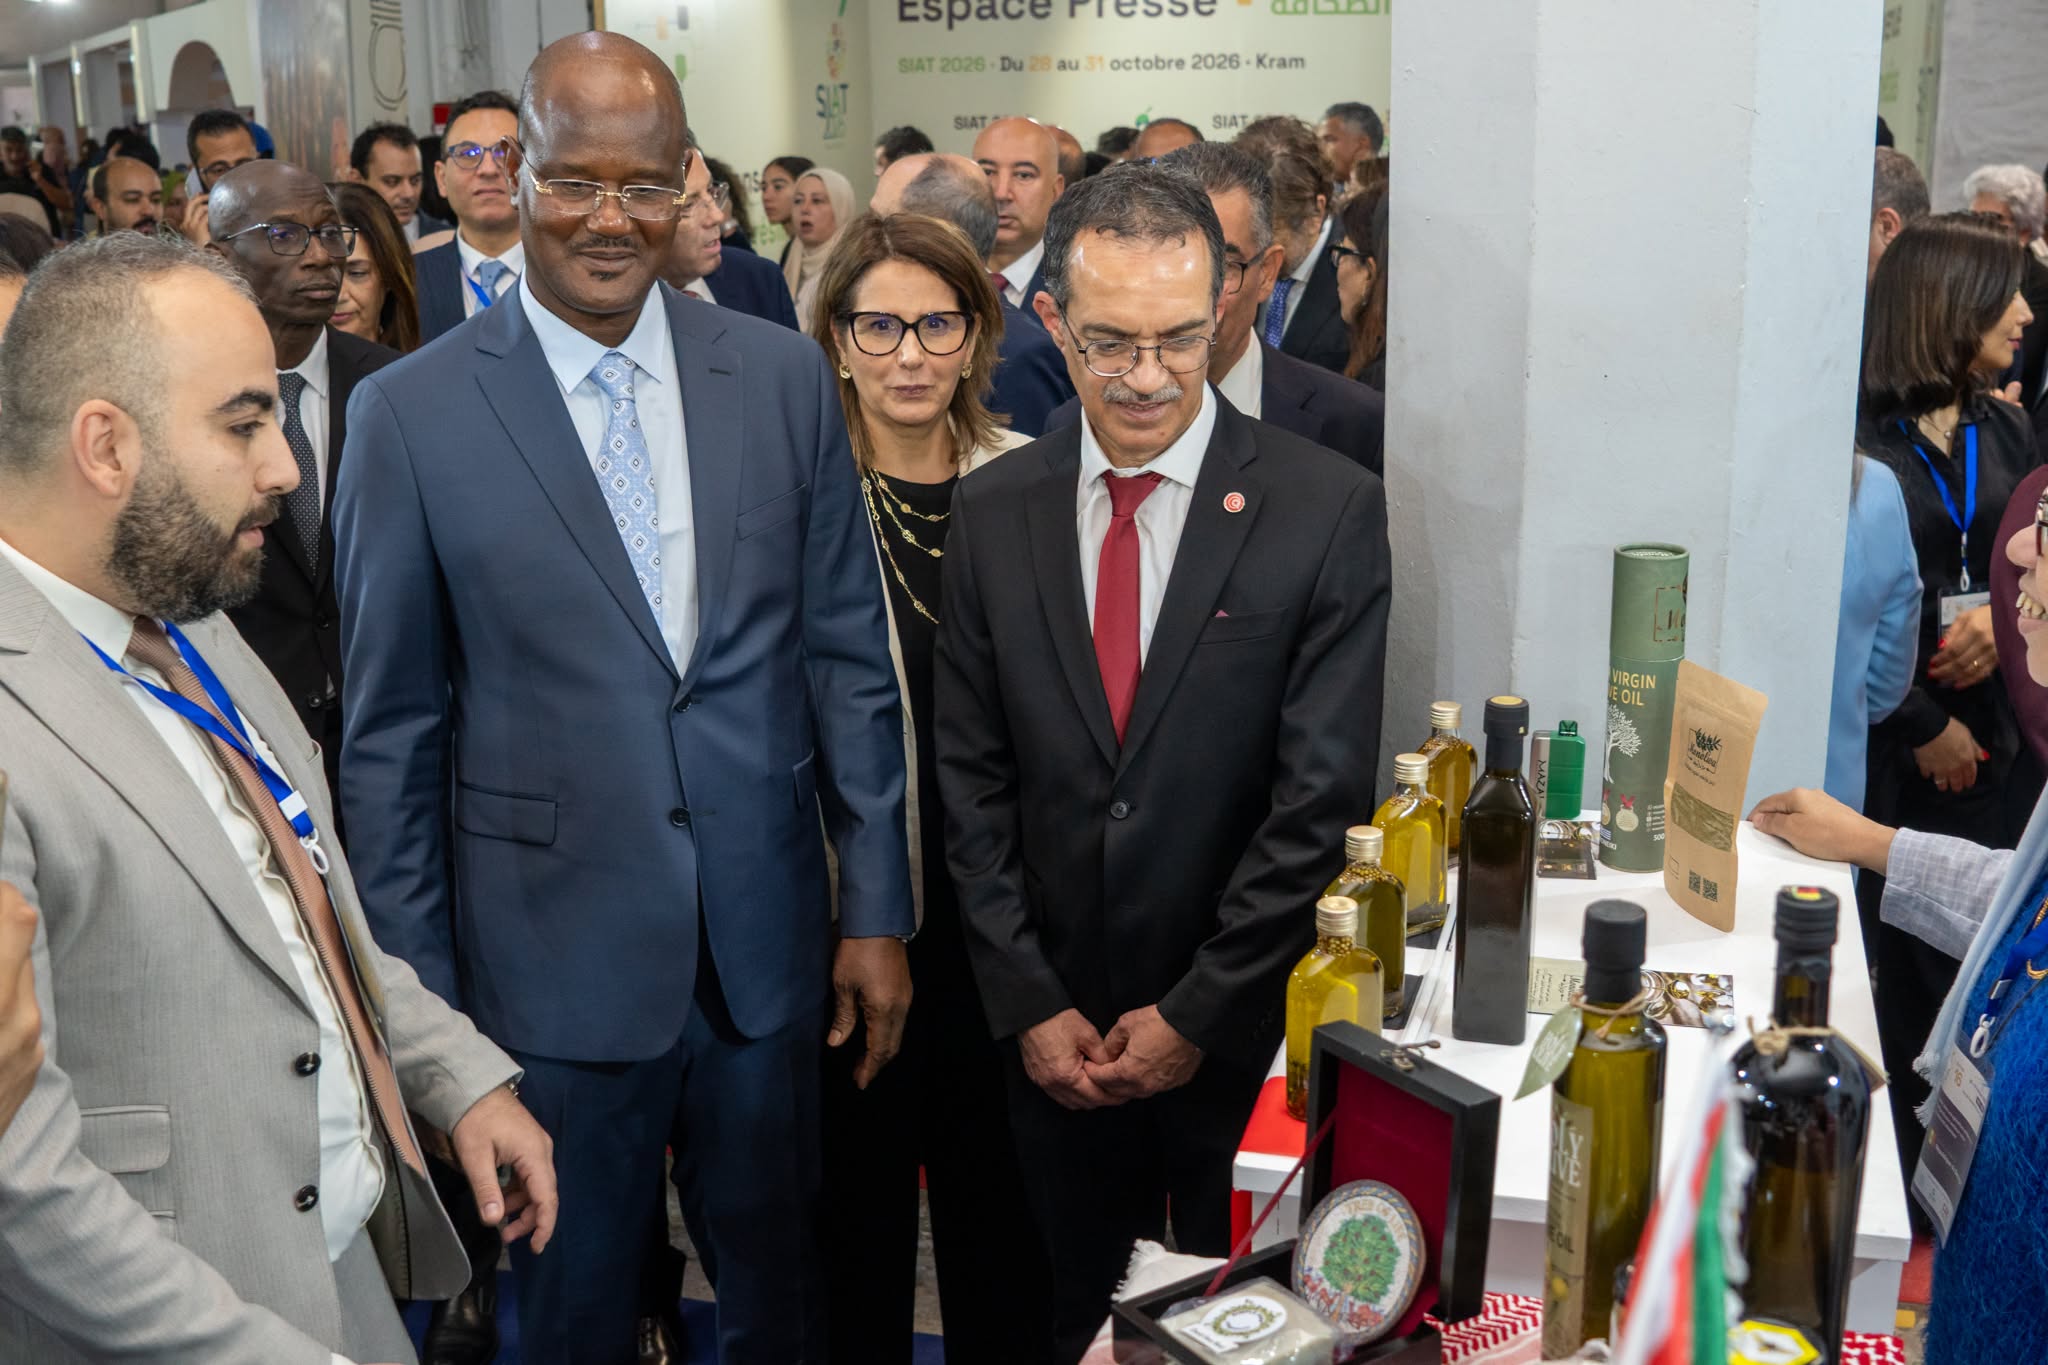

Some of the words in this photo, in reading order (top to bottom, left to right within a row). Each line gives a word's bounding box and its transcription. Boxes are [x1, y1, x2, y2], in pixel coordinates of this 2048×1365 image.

[897, 0, 1053, 31] Espace
[1067, 0, 1218, 18] Presse
[897, 56, 936, 73] SIAT
[999, 55, 1025, 72] Du
[1056, 58, 1080, 72] au
[1109, 53, 1186, 72] octobre
[1191, 53, 1241, 71] 2026
[1255, 52, 1307, 70] Kram
[953, 115, 988, 131] SIAT
[1212, 113, 1249, 129] SIAT
[1612, 668, 1657, 689] VIRGIN
[1621, 689, 1646, 707] OIL
